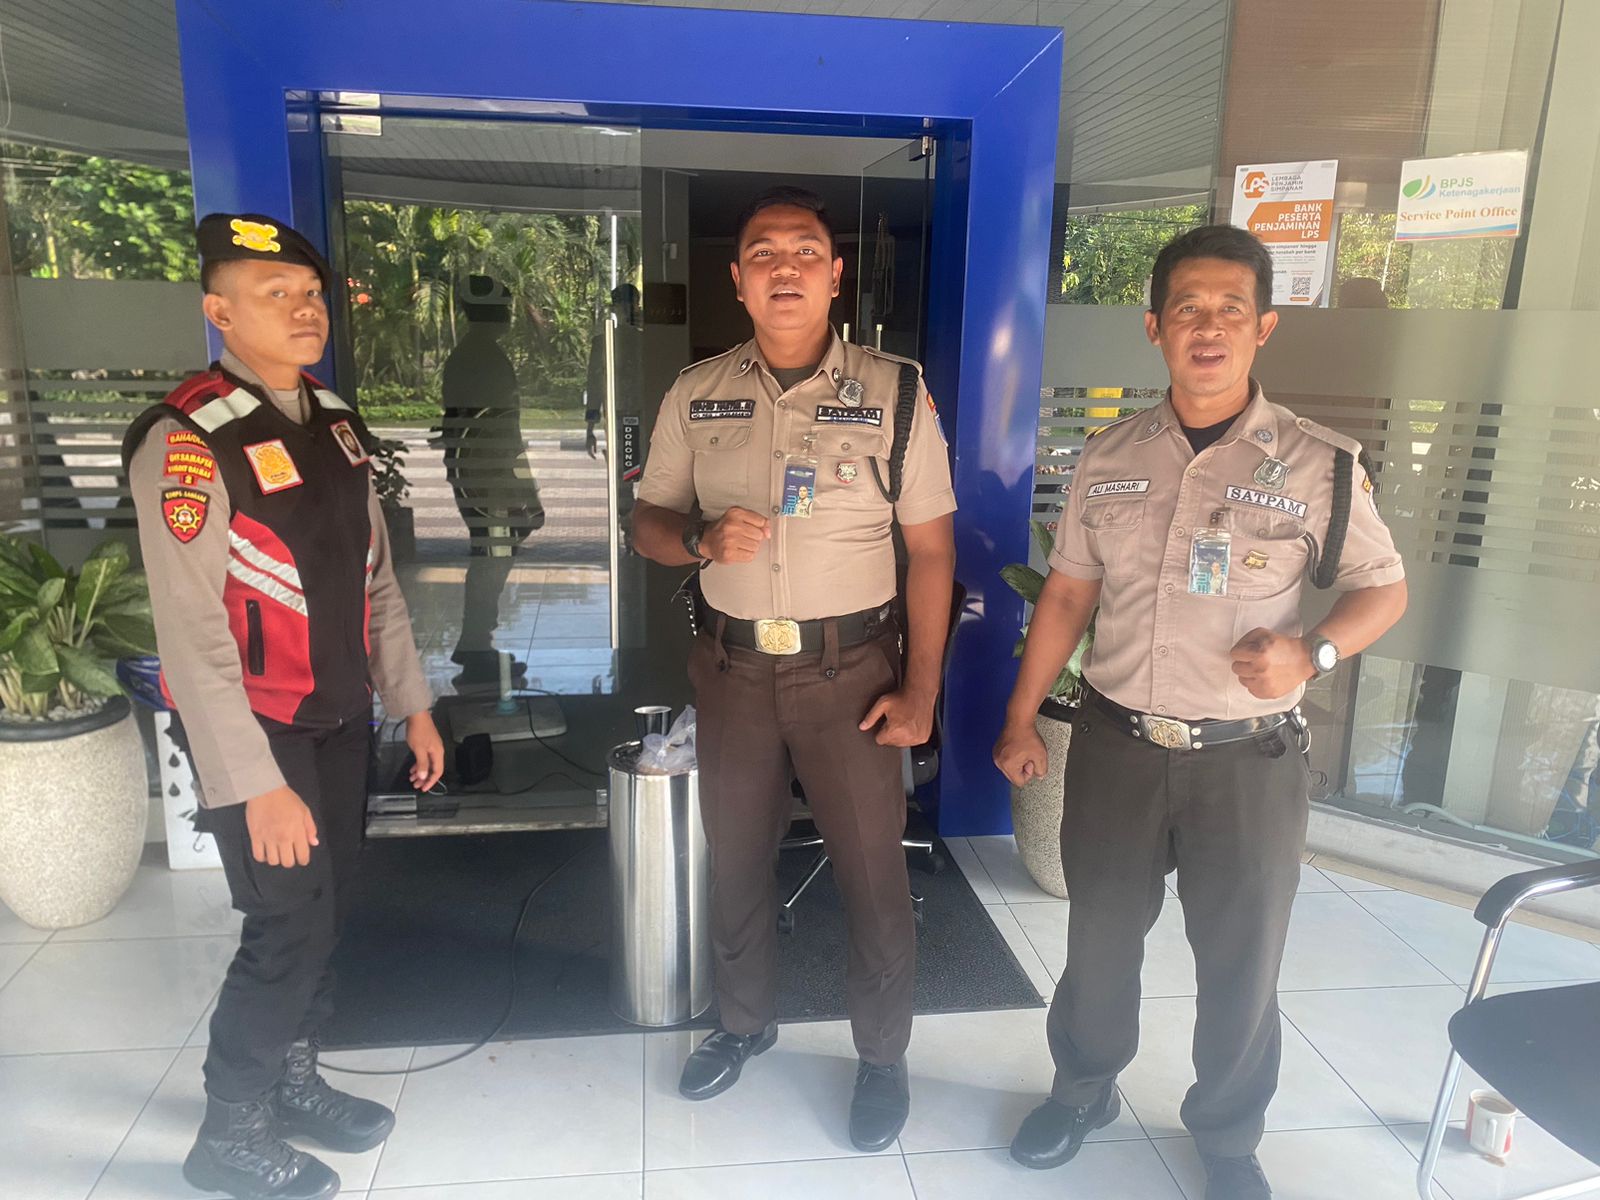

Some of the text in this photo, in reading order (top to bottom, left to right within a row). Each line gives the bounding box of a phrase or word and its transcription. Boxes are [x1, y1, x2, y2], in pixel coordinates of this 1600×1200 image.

[1440, 177, 1474, 188] BPJS
[1440, 186, 1520, 198] Ketenagakerjaan
[1294, 203, 1323, 212] BANK
[1278, 212, 1322, 222] PESERTA
[1400, 206, 1518, 221] Service Point Office
[1254, 221, 1320, 232] PENJAMINAN
[1301, 230, 1320, 239] LPS
[624, 426, 633, 467] DORONG
[1092, 482, 1140, 494] ALI MASHARI
[1231, 487, 1302, 515] SATPAM
